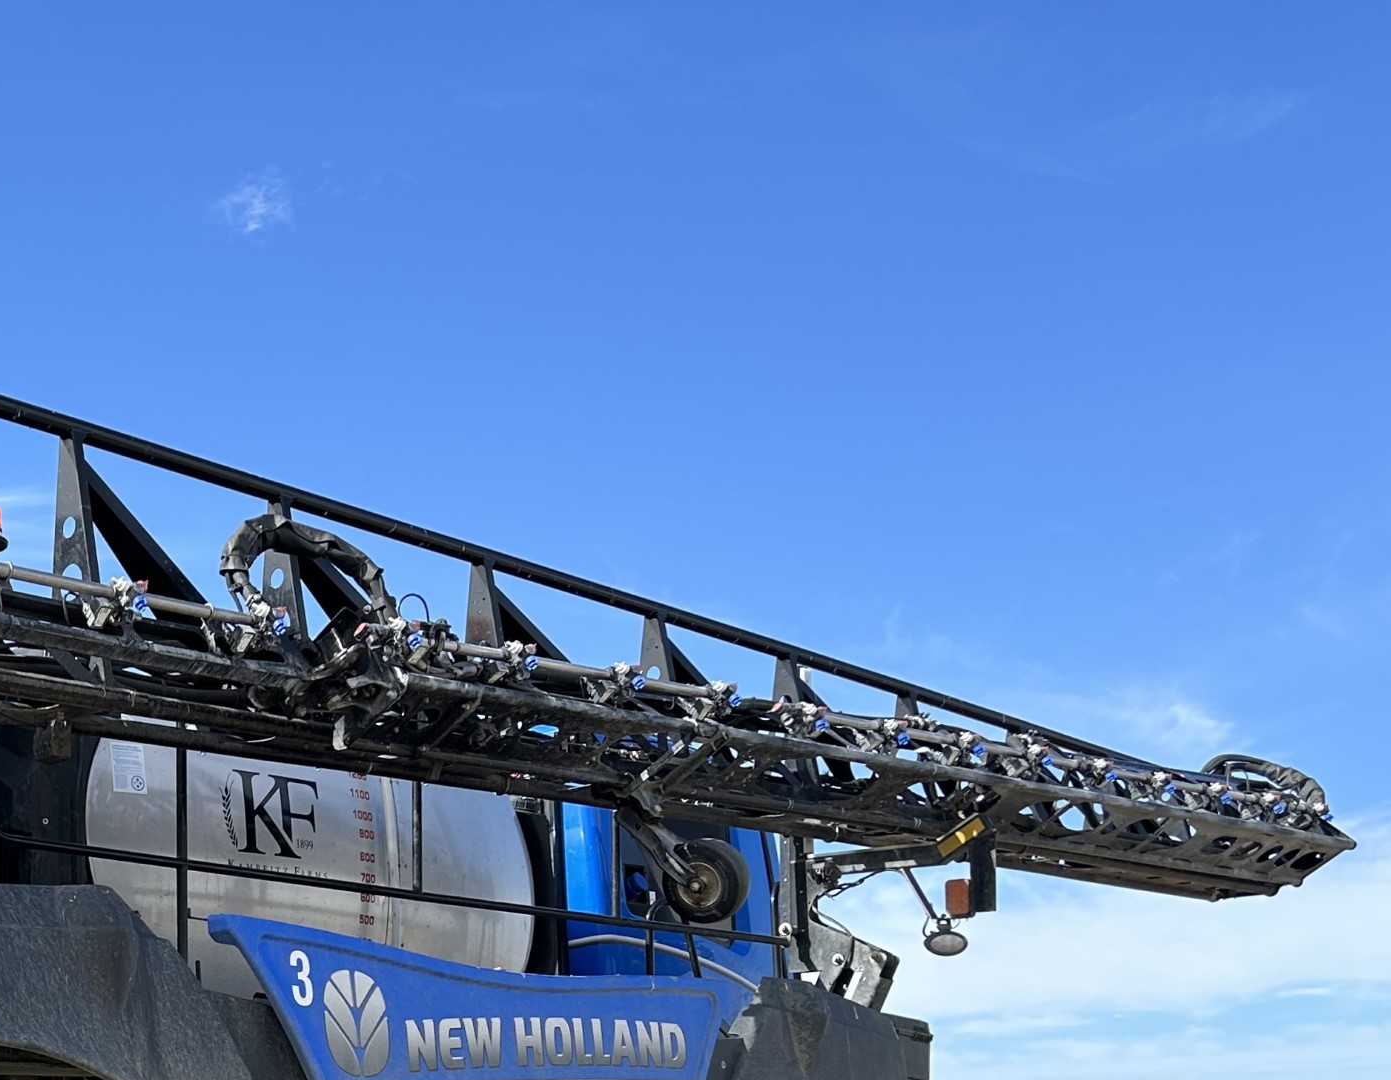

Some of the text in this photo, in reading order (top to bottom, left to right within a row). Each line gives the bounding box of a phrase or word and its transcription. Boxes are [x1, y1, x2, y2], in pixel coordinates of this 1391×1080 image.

[350, 788, 370, 800] 1100
[353, 810, 373, 821] 1000
[359, 829, 375, 840] 900
[296, 838, 313, 850] 1899
[360, 852, 375, 863] 800
[361, 873, 376, 884] 700
[360, 893, 375, 903] 600
[359, 914, 374, 925] 500
[289, 950, 314, 1006] 3
[406, 1017, 687, 1072] NEW HOLLAND
